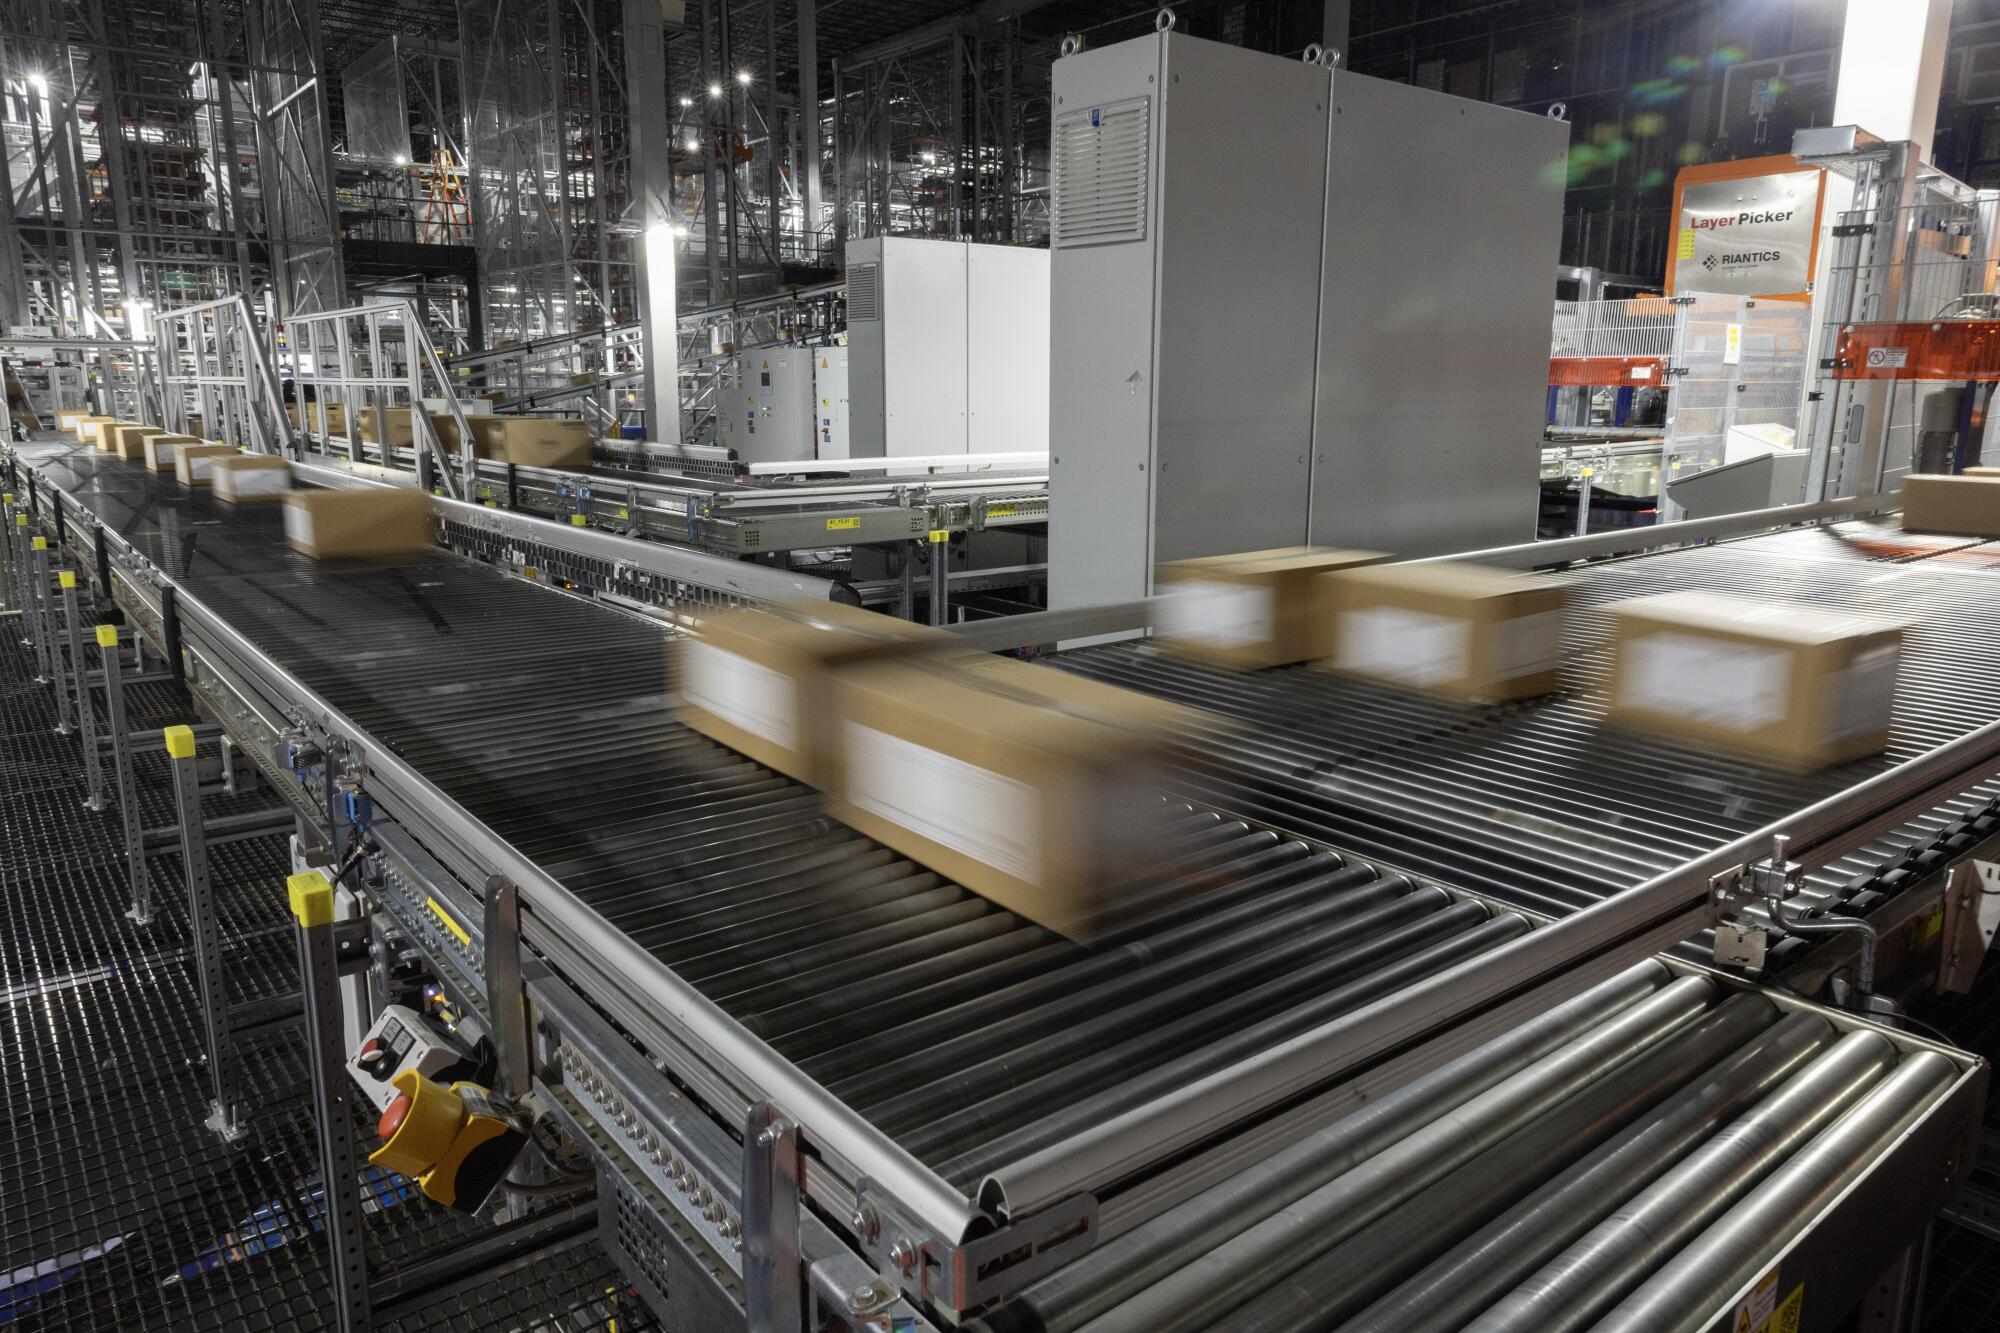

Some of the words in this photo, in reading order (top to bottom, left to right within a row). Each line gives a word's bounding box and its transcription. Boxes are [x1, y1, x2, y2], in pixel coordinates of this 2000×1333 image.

[1691, 216, 1735, 231] Layer
[1738, 211, 1793, 225] Picker
[1722, 251, 1780, 265] RIANTICS
